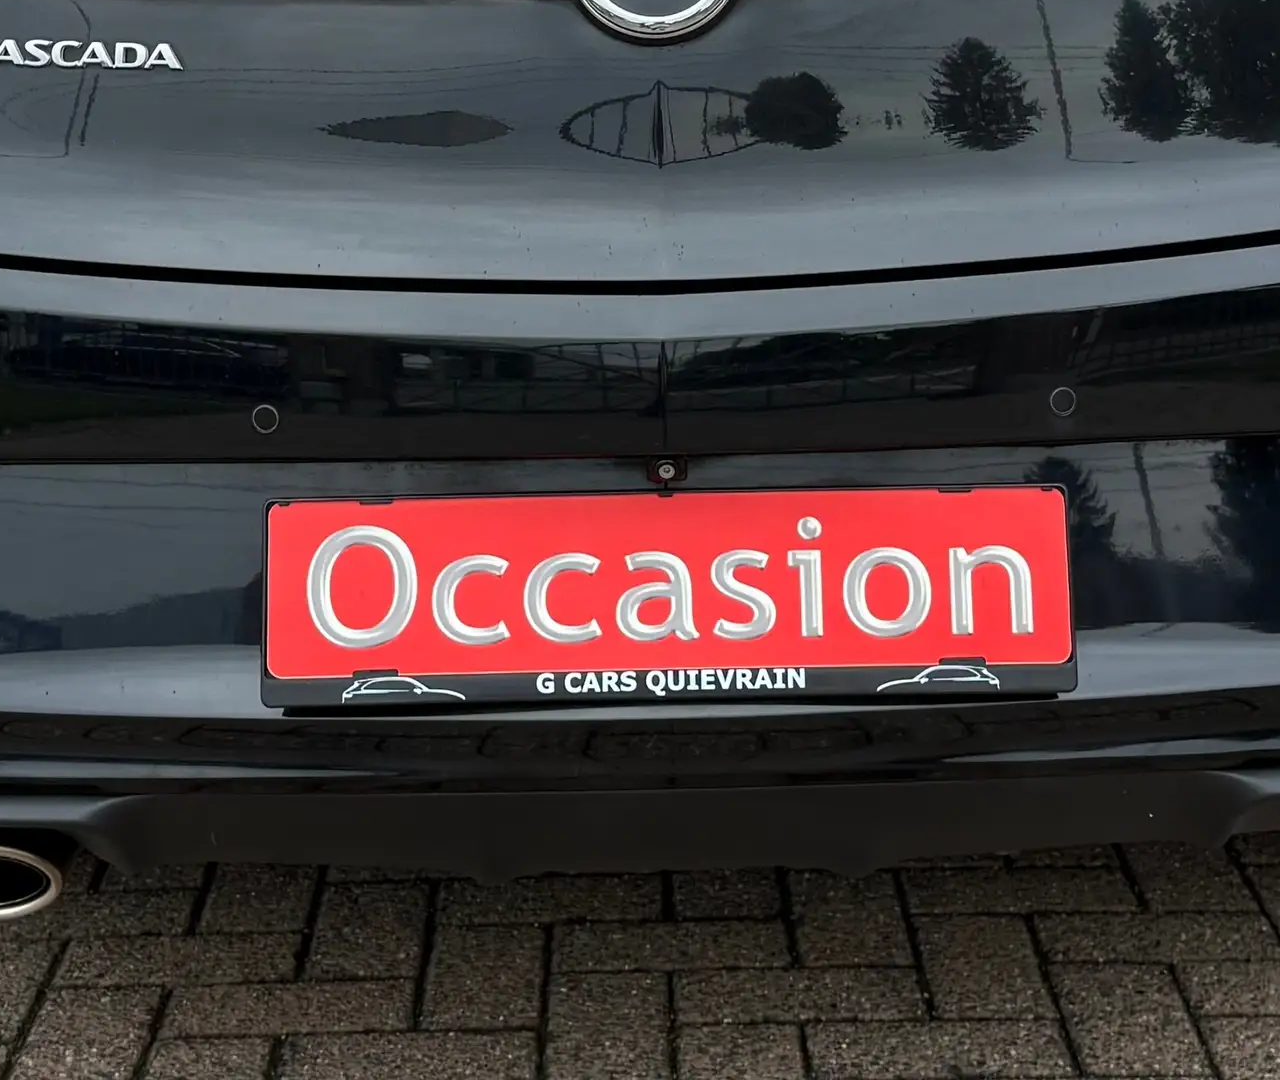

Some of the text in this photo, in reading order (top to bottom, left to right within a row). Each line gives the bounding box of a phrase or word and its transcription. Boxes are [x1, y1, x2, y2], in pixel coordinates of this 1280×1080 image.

[305, 516, 1035, 650] Occasion
[535, 667, 807, 696] G CARS QUIEVRAIN
